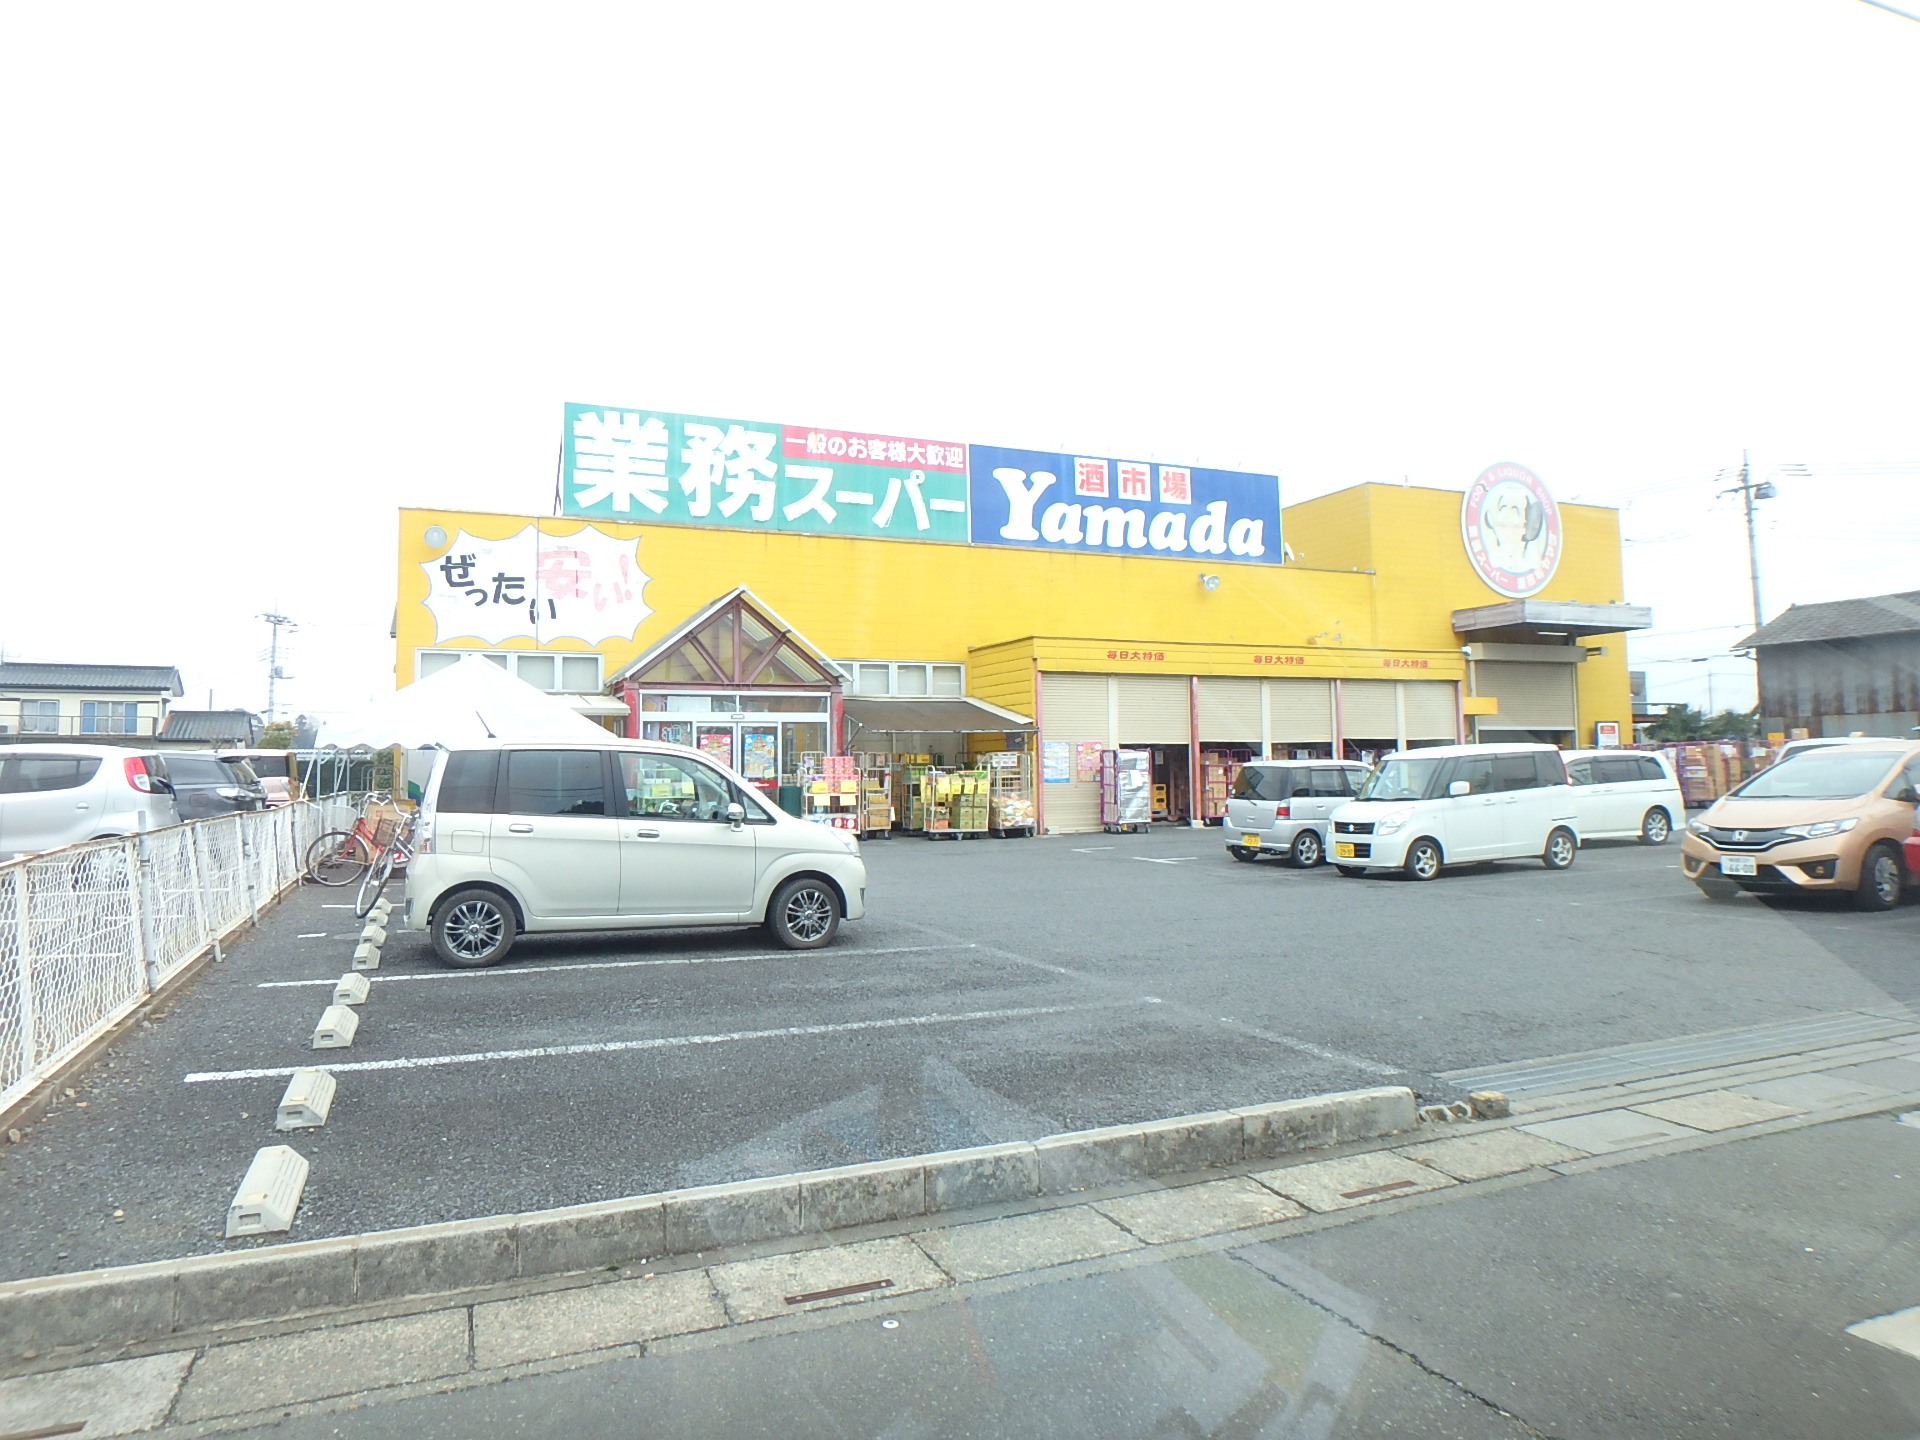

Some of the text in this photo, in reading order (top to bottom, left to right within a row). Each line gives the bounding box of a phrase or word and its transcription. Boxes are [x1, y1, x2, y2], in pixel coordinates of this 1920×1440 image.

[785, 431, 964, 468] 一般のお客様大歓迎
[573, 410, 966, 531] 業務スーパー
[1078, 462, 1187, 500] 酒市場
[993, 468, 1266, 557] Yamada
[439, 553, 557, 625] ぜったい
[1106, 650, 1165, 661] 毎日大特価
[1253, 655, 1305, 665] 毎日大特価
[1382, 658, 1429, 668] 毎日大特価
